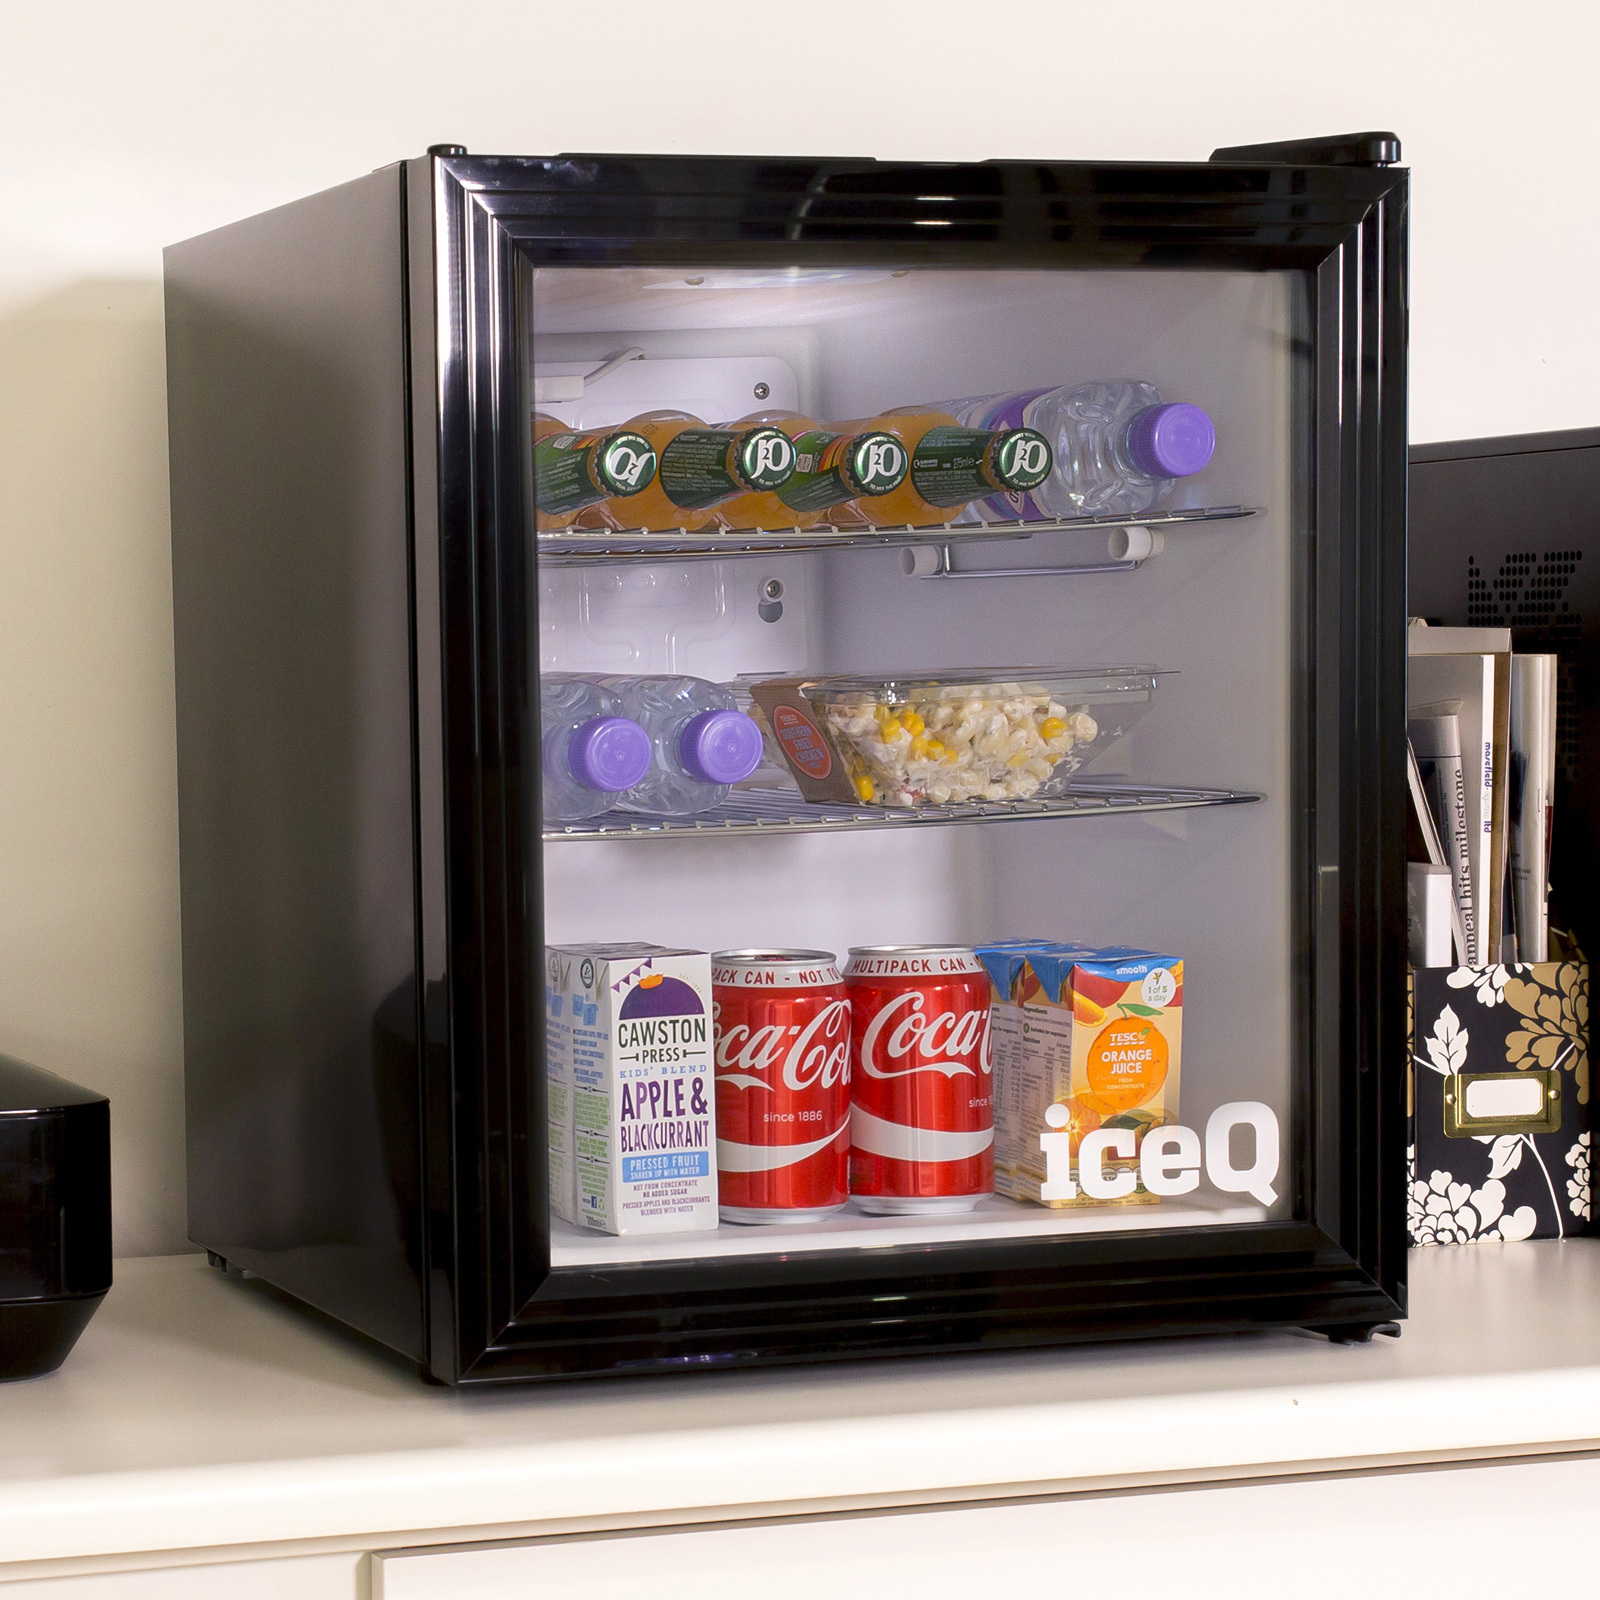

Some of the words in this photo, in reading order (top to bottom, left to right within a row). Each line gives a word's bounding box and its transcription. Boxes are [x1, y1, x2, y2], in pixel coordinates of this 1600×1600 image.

[750, 438, 791, 479] J2O
[862, 443, 902, 484] J2O
[1005, 439, 1048, 478] J2O
[1483, 821, 1491, 833] ltd
[1459, 865, 1472, 900] hits
[851, 959, 932, 973] MULTIPACK
[939, 958, 966, 971] CAN
[1116, 964, 1147, 975] smooth
[744, 971, 775, 984] CAN
[798, 970, 824, 984] NOT
[826, 967, 840, 980] TO
[1148, 986, 1152, 994] 1
[1153, 985, 1161, 994] of
[1162, 985, 1168, 993] 5
[1153, 994, 1167, 1002] day
[618, 1018, 706, 1048] CAWSTON
[642, 1047, 680, 1064] PRESS
[1101, 1048, 1152, 1062] ORANGE
[619, 1066, 653, 1079] KIDS'
[661, 1064, 707, 1075] BLEND
[1110, 1062, 1142, 1075] JUICE
[621, 1078, 686, 1122] APPLE
[691, 1077, 708, 1115] &
[968, 1097, 988, 1108] since
[763, 1111, 795, 1122] since
[798, 1110, 823, 1121] 1886
[620, 1120, 709, 1153] BLACKCURRANT
[1040, 1101, 1280, 1207] iceQ
[630, 1156, 669, 1172] PRESSED
[672, 1154, 700, 1168] FRUIT
[654, 1169, 663, 1178] UP
[663, 1168, 678, 1177] WITH
[679, 1166, 700, 1176] WATER
[633, 1183, 643, 1192] NOT
[644, 1182, 659, 1191] FROM
[660, 1180, 698, 1189] CONCENTRATE
[651, 1189, 669, 1198] ADDED
[670, 1188, 688, 1196] SUGAR
[622, 1201, 643, 1210] PRESSED
[662, 1198, 671, 1206] AND
[672, 1195, 711, 1205] BLACKCURRANTS
[640, 1207, 663, 1216] BLENDED
[663, 1206, 676, 1214] WITH
[677, 1205, 694, 1213] WATER
